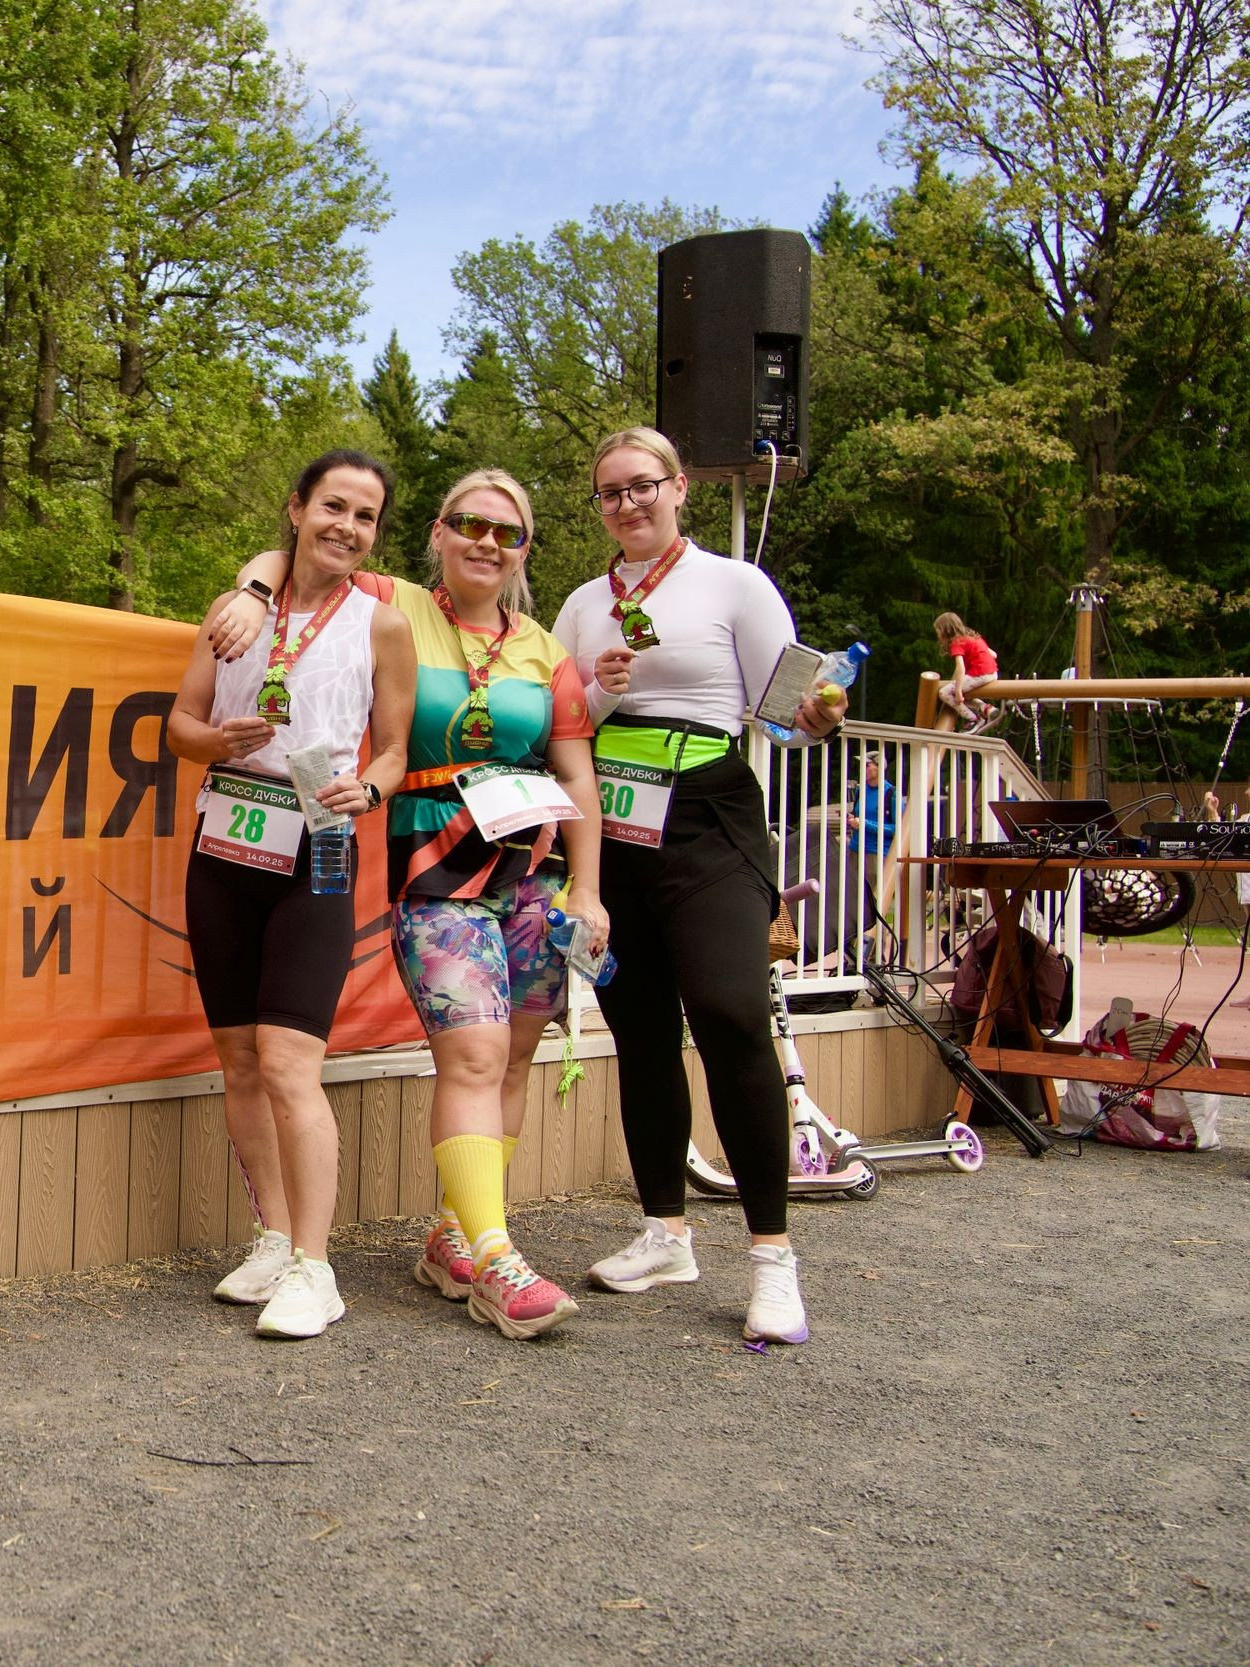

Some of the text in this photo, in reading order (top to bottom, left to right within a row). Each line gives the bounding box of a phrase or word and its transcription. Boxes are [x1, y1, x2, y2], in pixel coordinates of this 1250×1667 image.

[468, 765, 509, 782] КРОСС
[621, 767, 662, 782] ДУБКИ
[219, 781, 297, 806] КРОСС ДУБКИ
[512, 778, 534, 805] 1
[600, 781, 635, 818] 30
[227, 804, 266, 843] 28
[616, 827, 651, 840] 14.09.25
[207, 842, 283, 867] Апрелевка 14.09.25
